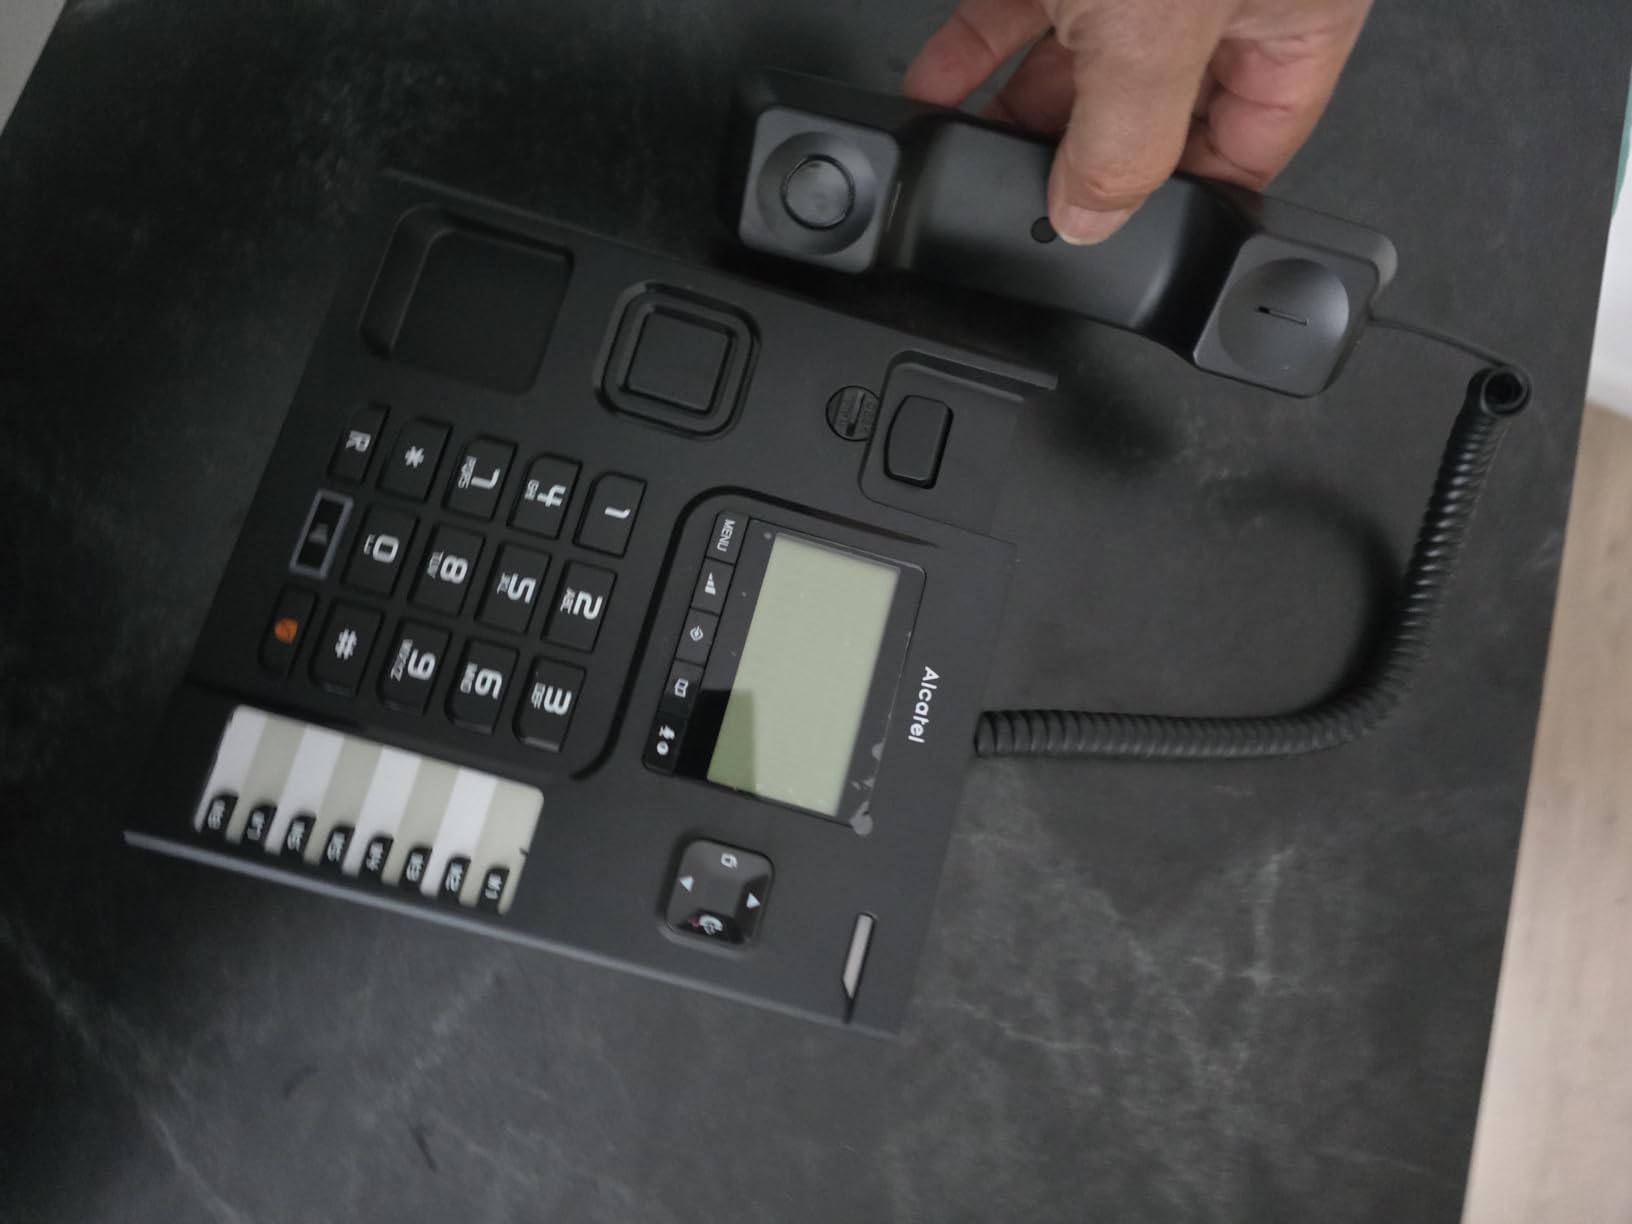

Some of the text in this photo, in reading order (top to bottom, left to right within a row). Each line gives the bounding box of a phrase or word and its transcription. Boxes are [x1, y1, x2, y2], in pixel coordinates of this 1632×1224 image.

[345, 430, 371, 452] R
[471, 468, 500, 490] 7
[537, 484, 567, 507] 4
[604, 506, 631, 520] 1
[372, 534, 399, 563] 0
[715, 518, 737, 553] MENU
[440, 555, 468, 584] 8
[507, 573, 536, 603] 5
[560, 587, 575, 614] ABC
[573, 591, 602, 620] 2
[335, 629, 357, 660] #
[407, 649, 435, 680] 9
[474, 668, 502, 699] 6
[543, 686, 572, 715] 3
[907, 665, 940, 743] Alcatel
